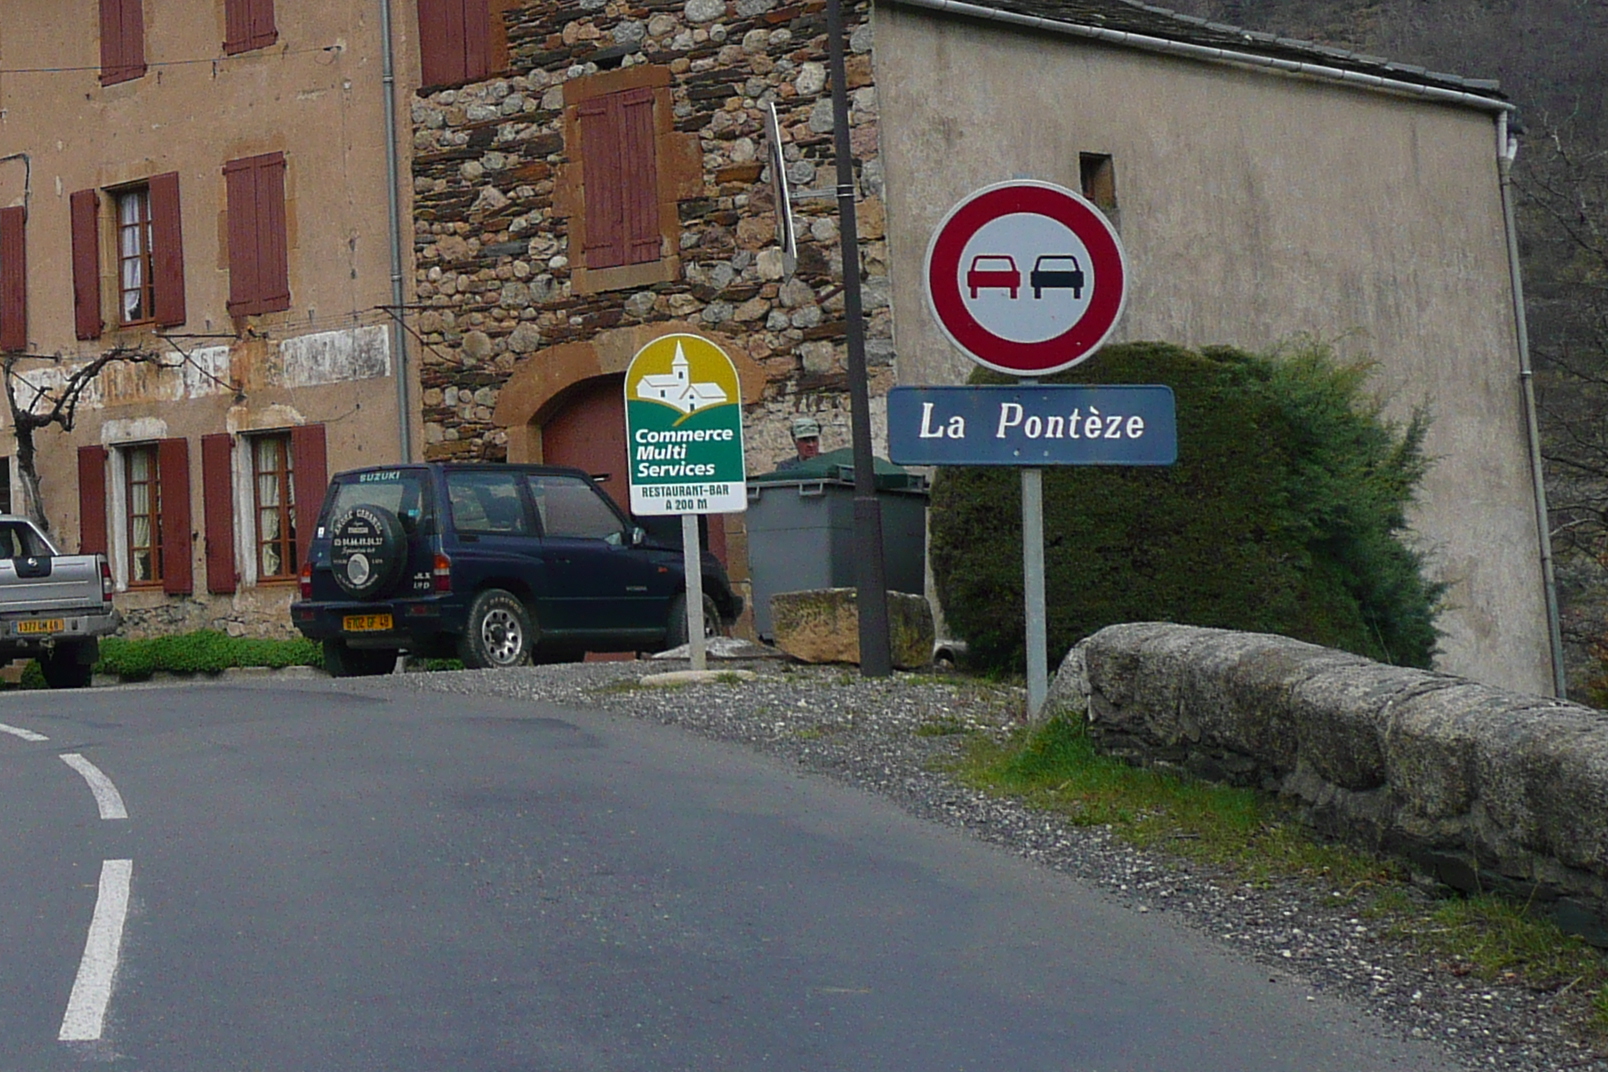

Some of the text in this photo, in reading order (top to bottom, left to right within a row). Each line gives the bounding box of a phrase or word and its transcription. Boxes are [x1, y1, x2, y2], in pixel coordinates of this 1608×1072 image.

[918, 401, 1145, 439] La Pontèze
[635, 428, 734, 444] Commerce
[636, 443, 687, 461] Multi
[360, 471, 400, 482] SUZUKI
[637, 461, 716, 478] Services
[641, 484, 730, 498] RESTAURANT-BAR
[675, 499, 694, 511] 200
[697, 498, 708, 510] M
